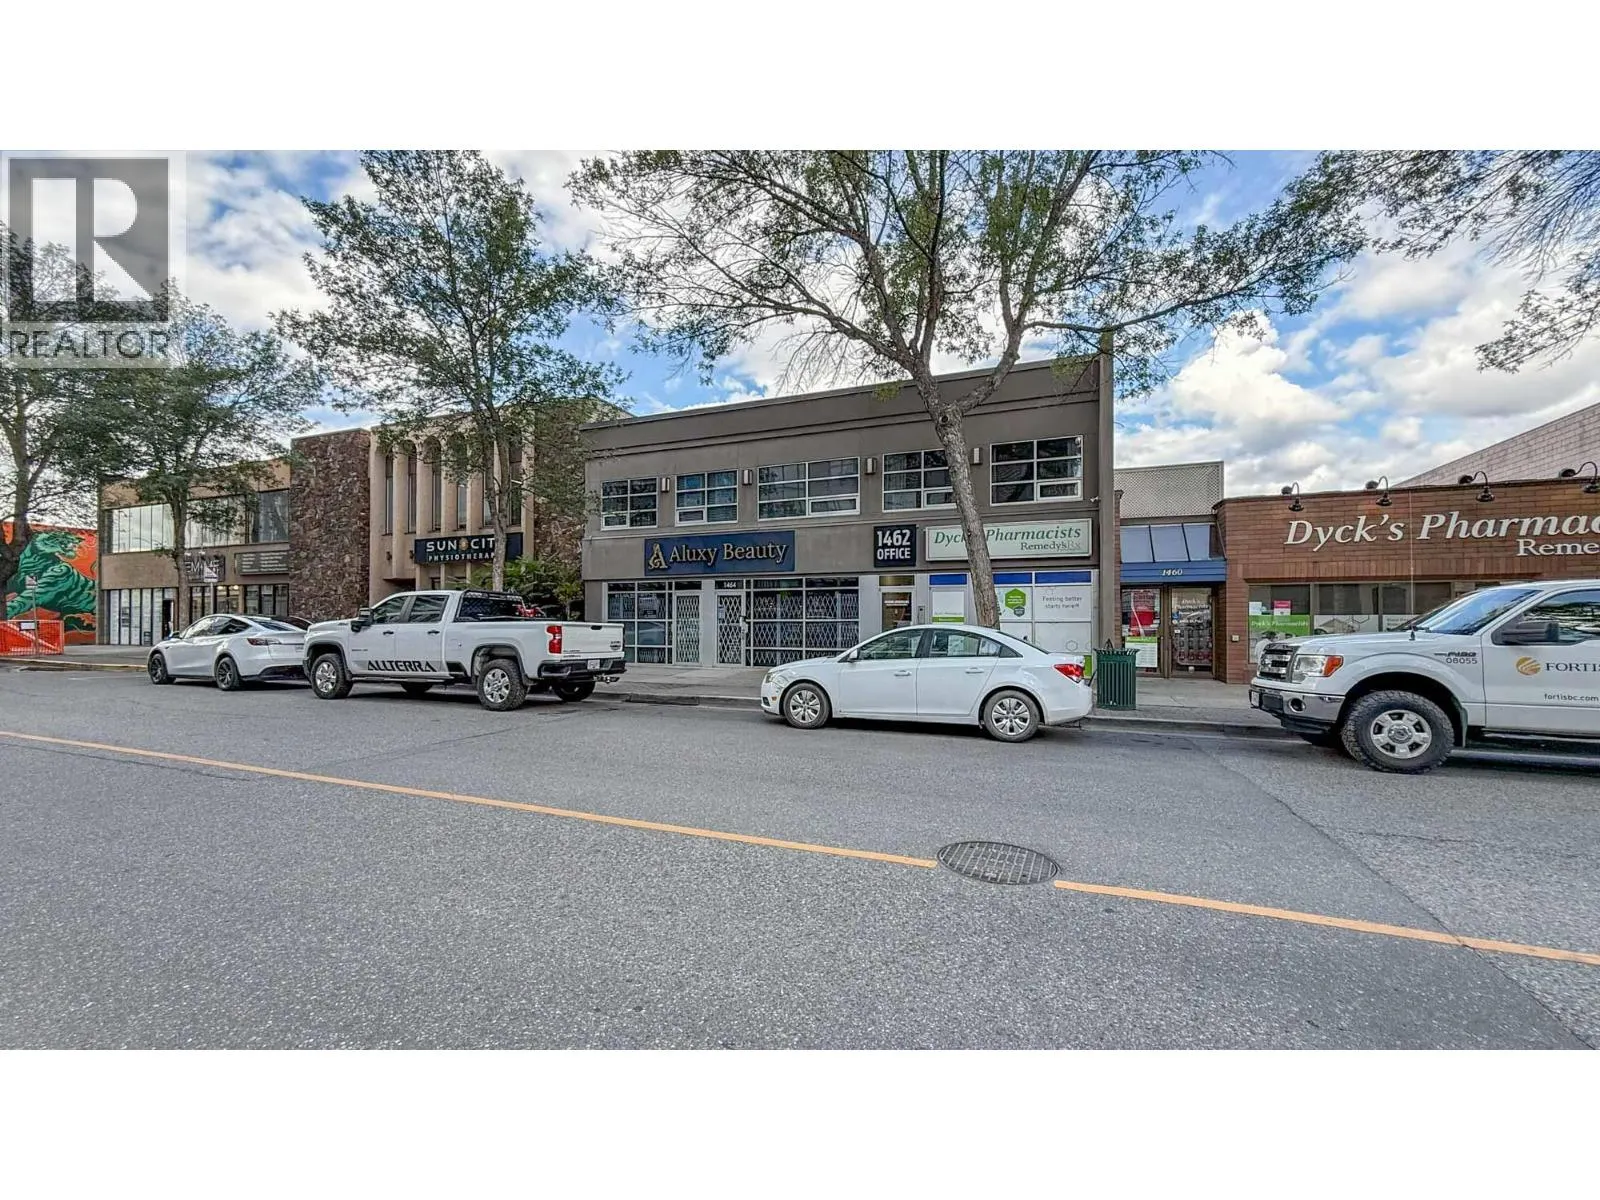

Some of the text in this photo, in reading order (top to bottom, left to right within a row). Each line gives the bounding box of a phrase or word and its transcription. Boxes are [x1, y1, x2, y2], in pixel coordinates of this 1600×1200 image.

[876, 529, 911, 546] 1462
[934, 525, 1081, 548] Dyc Pharmacists
[1283, 515, 1405, 551] Dyck's
[426, 538, 496, 552] SUN CIT
[669, 544, 718, 566] Aluxy
[723, 542, 787, 563] Beauty
[876, 547, 911, 560] OFFICE
[1162, 568, 1183, 576] 1460
[368, 660, 437, 672] ALLTERRA
[1445, 657, 1478, 665] 08055
[1545, 662, 1600, 672] FORTI
[1544, 693, 1600, 702] fortisbc.com
